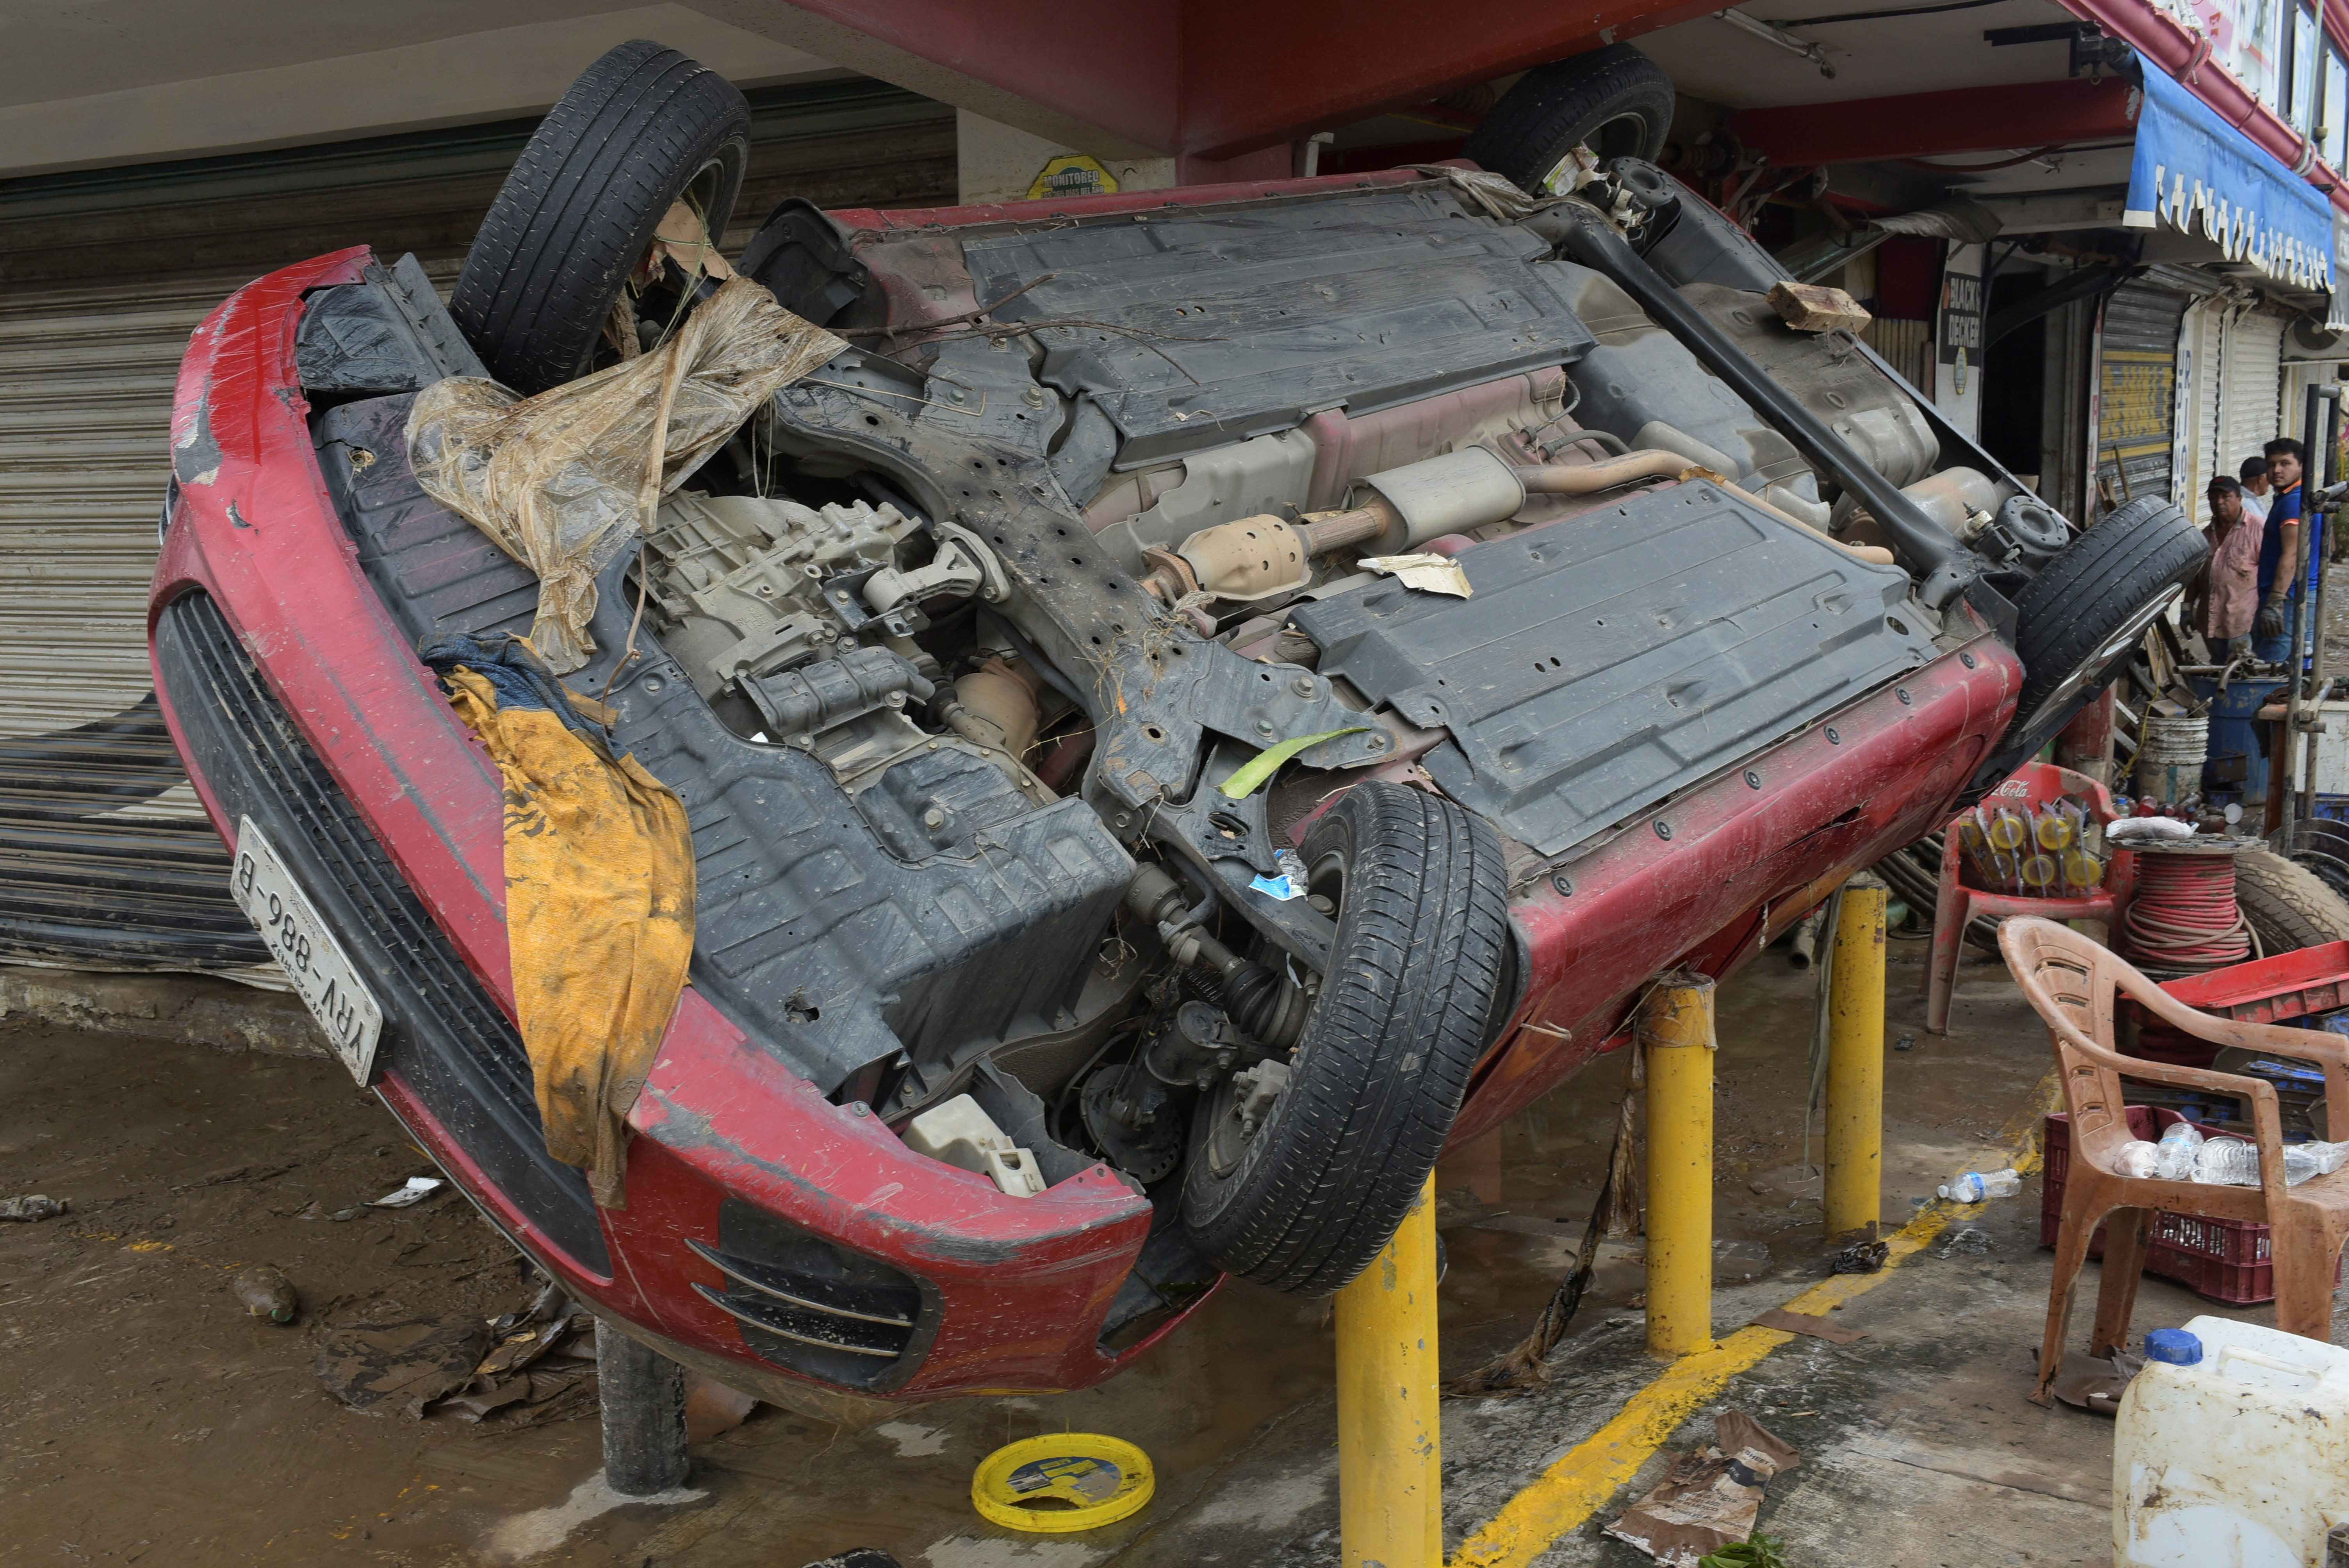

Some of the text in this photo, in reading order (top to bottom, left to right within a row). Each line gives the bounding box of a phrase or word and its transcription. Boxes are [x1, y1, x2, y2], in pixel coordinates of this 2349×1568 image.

[1044, 170, 1098, 188] MONITOREO
[1948, 315, 1979, 347] DECKER
[237, 852, 364, 1060] YRV-886-B
[1745, 1450, 1770, 1465] SHEET
